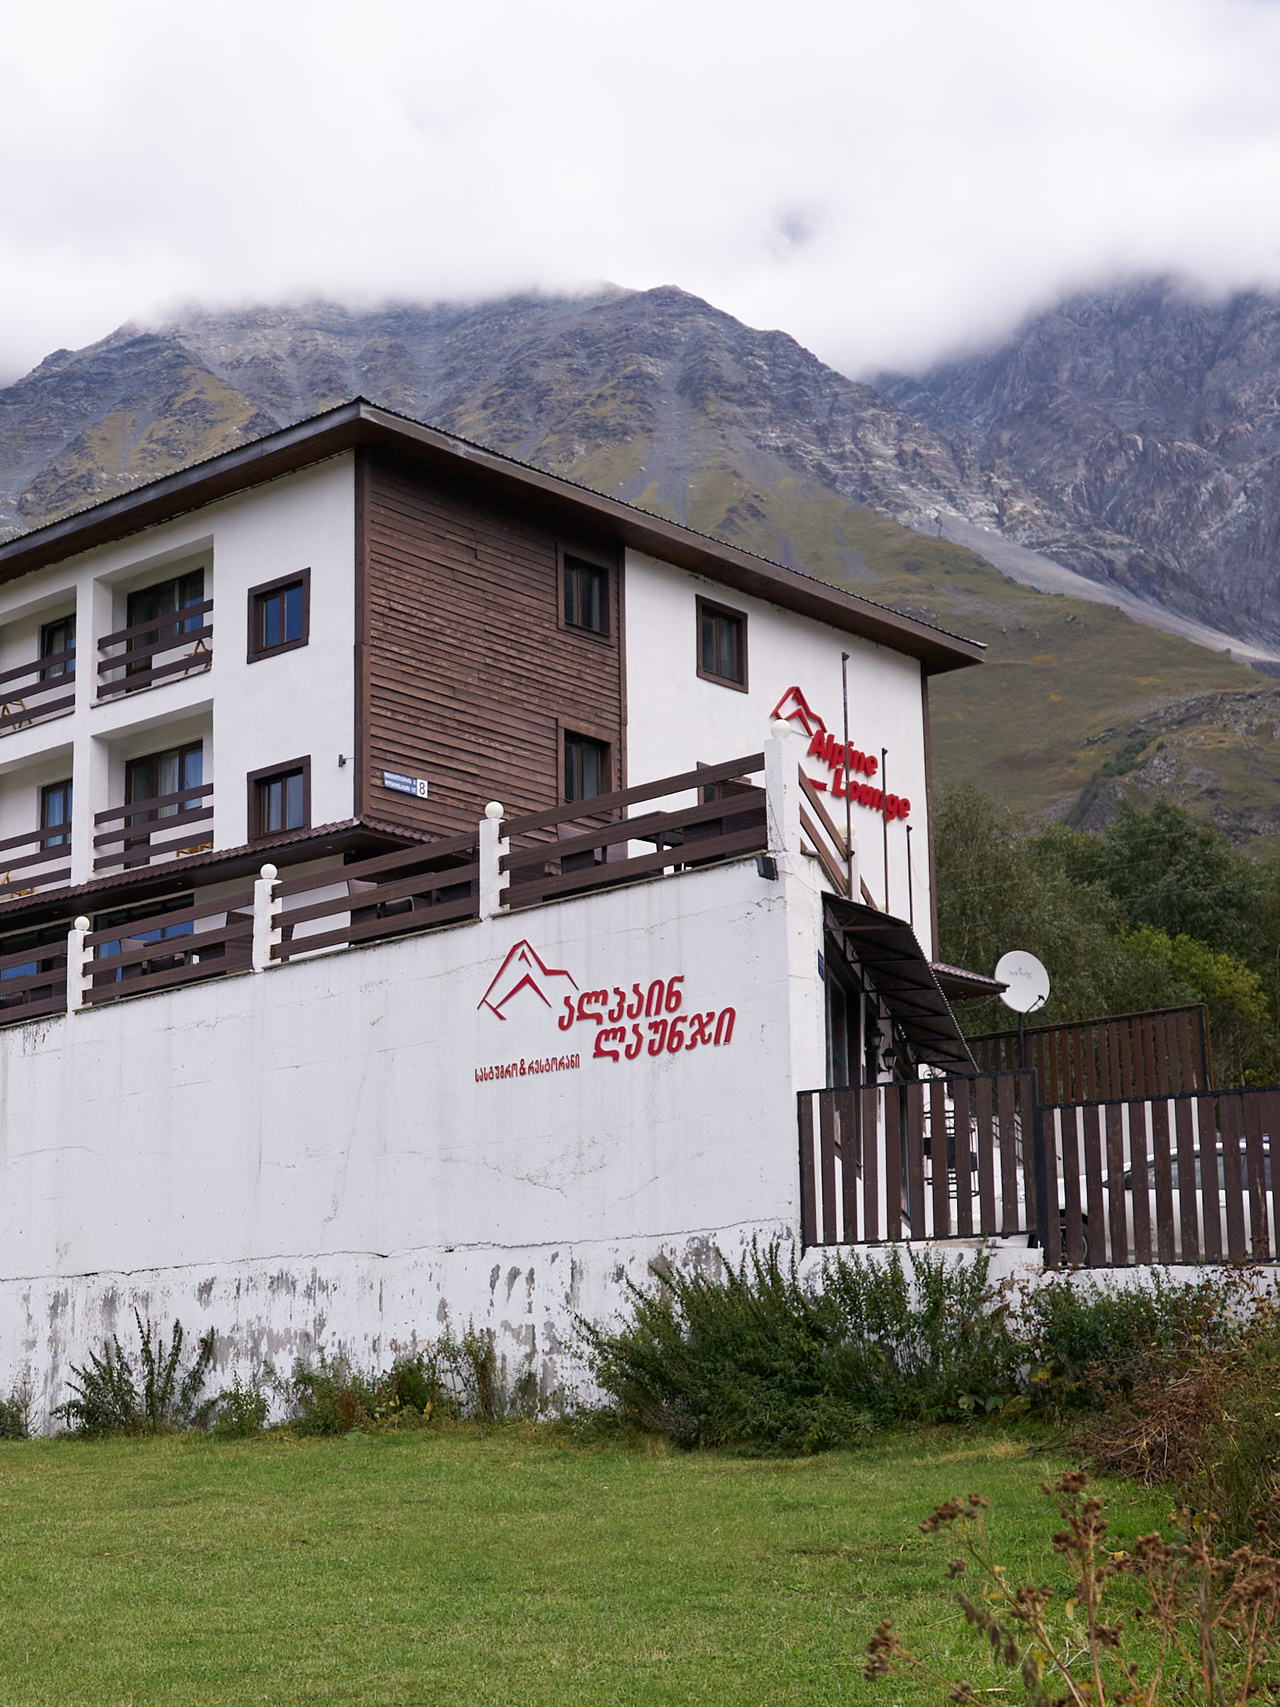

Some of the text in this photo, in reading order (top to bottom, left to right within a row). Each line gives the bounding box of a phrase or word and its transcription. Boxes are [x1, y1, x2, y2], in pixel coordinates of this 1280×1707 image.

[807, 729, 878, 777] Alpine
[419, 782, 425, 795] 8
[832, 768, 911, 822] Lounge
[558, 975, 685, 1031] ალპაინ
[593, 1007, 737, 1062] ლაუნჯი
